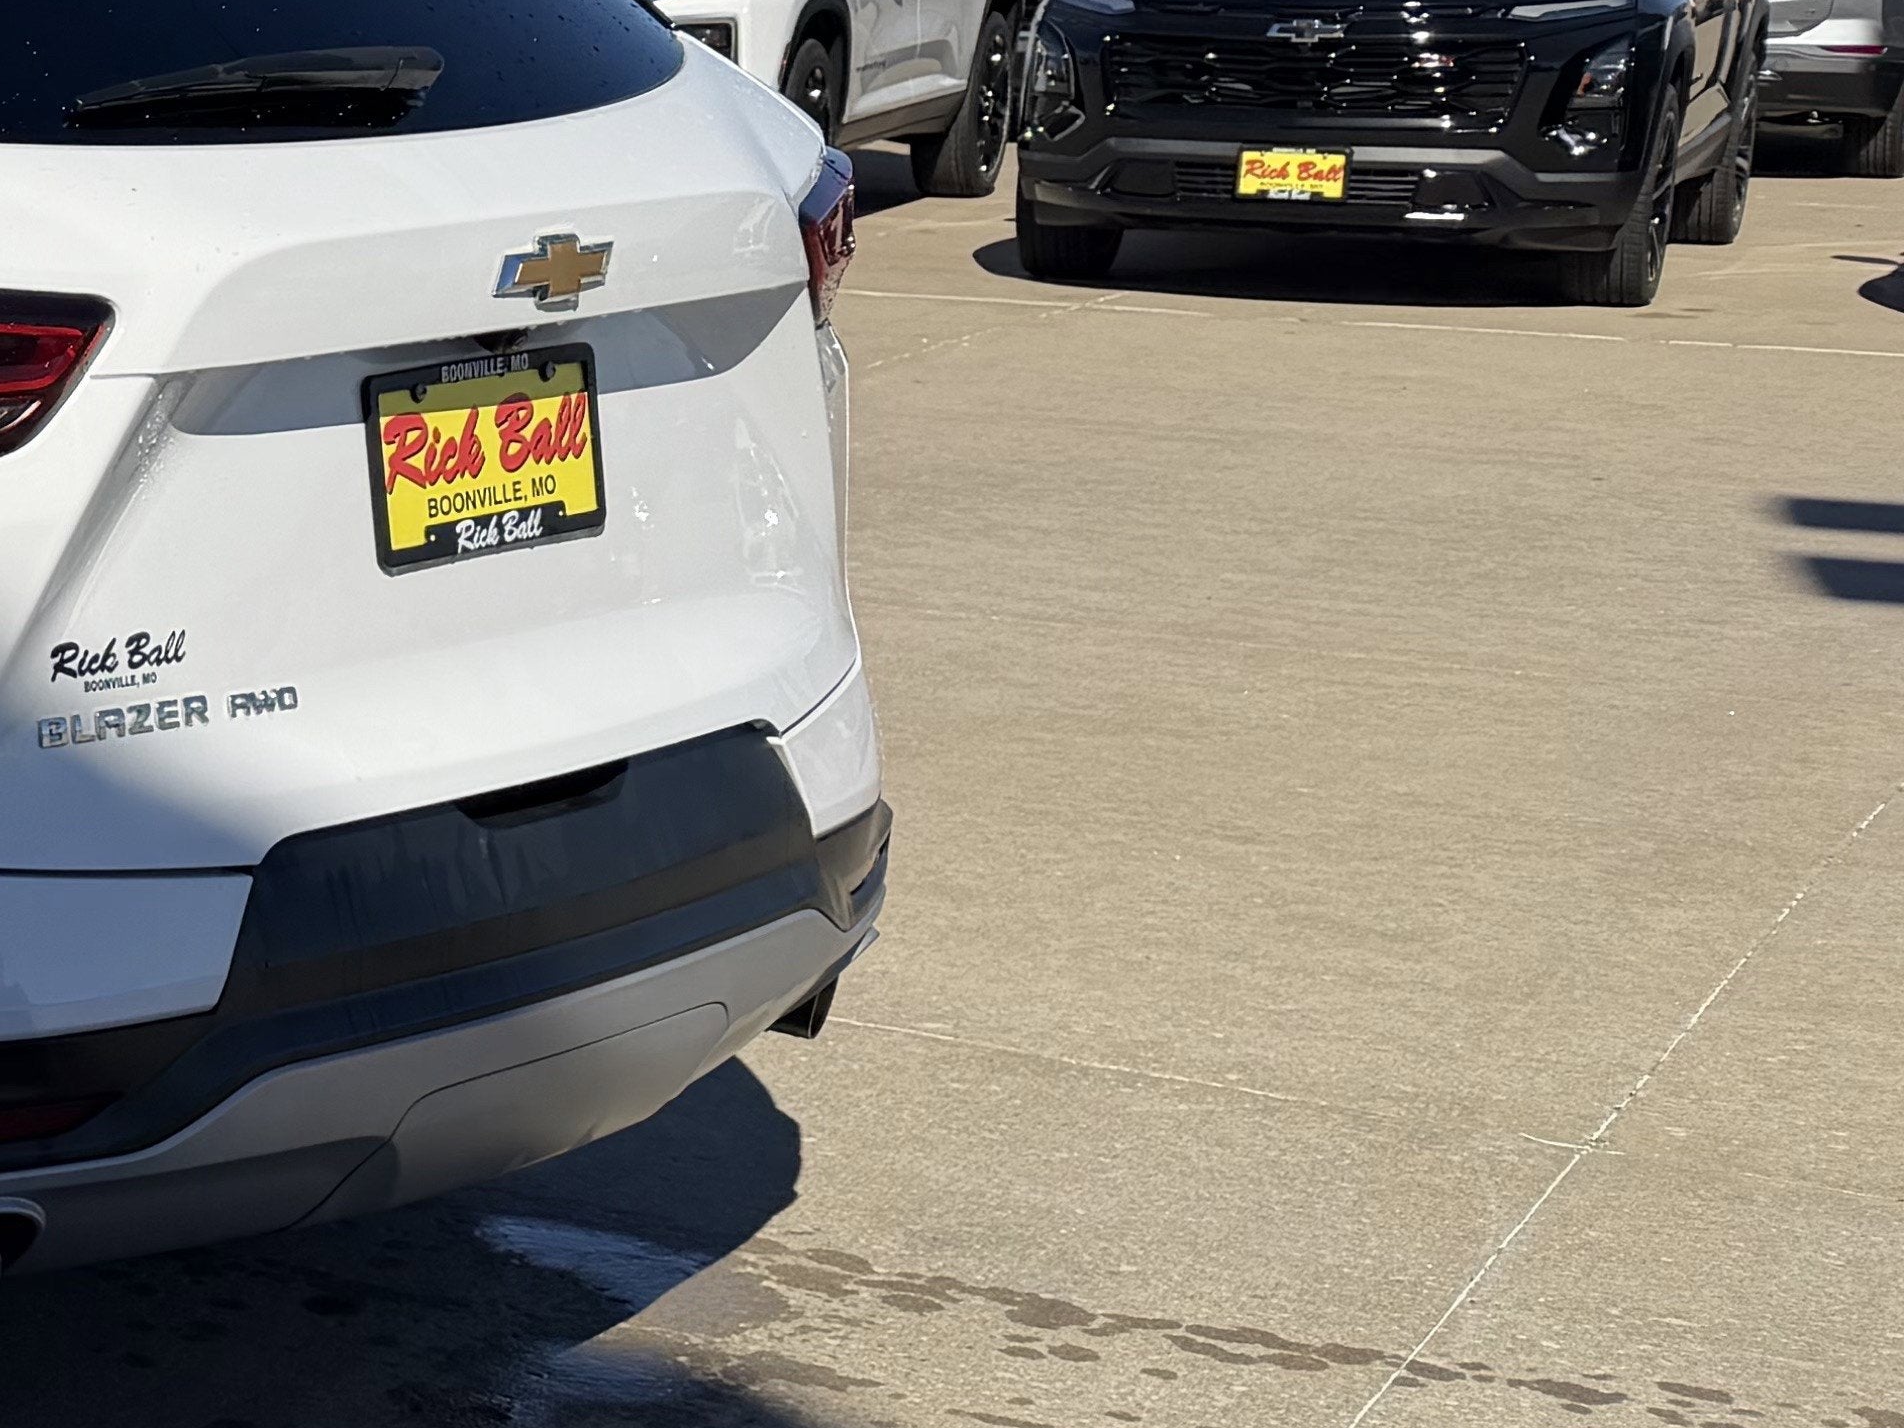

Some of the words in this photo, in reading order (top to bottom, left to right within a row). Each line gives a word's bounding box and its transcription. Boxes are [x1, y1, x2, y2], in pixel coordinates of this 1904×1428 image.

[1243, 159, 1290, 180] Rick
[1297, 161, 1344, 182] Ball
[511, 353, 529, 371] MO
[383, 404, 486, 495] Rick
[494, 388, 588, 473] Ball
[427, 480, 528, 519] BOONVILLE,
[531, 474, 557, 498] MO
[455, 515, 500, 553] Rick
[502, 508, 543, 543] Ball
[50, 637, 119, 683] Rick
[125, 629, 186, 670] Ball
[83, 674, 140, 693] BOONVILLE,
[142, 671, 158, 685] MO
[37, 694, 210, 750] BLAZER
[227, 686, 299, 719] AWD
